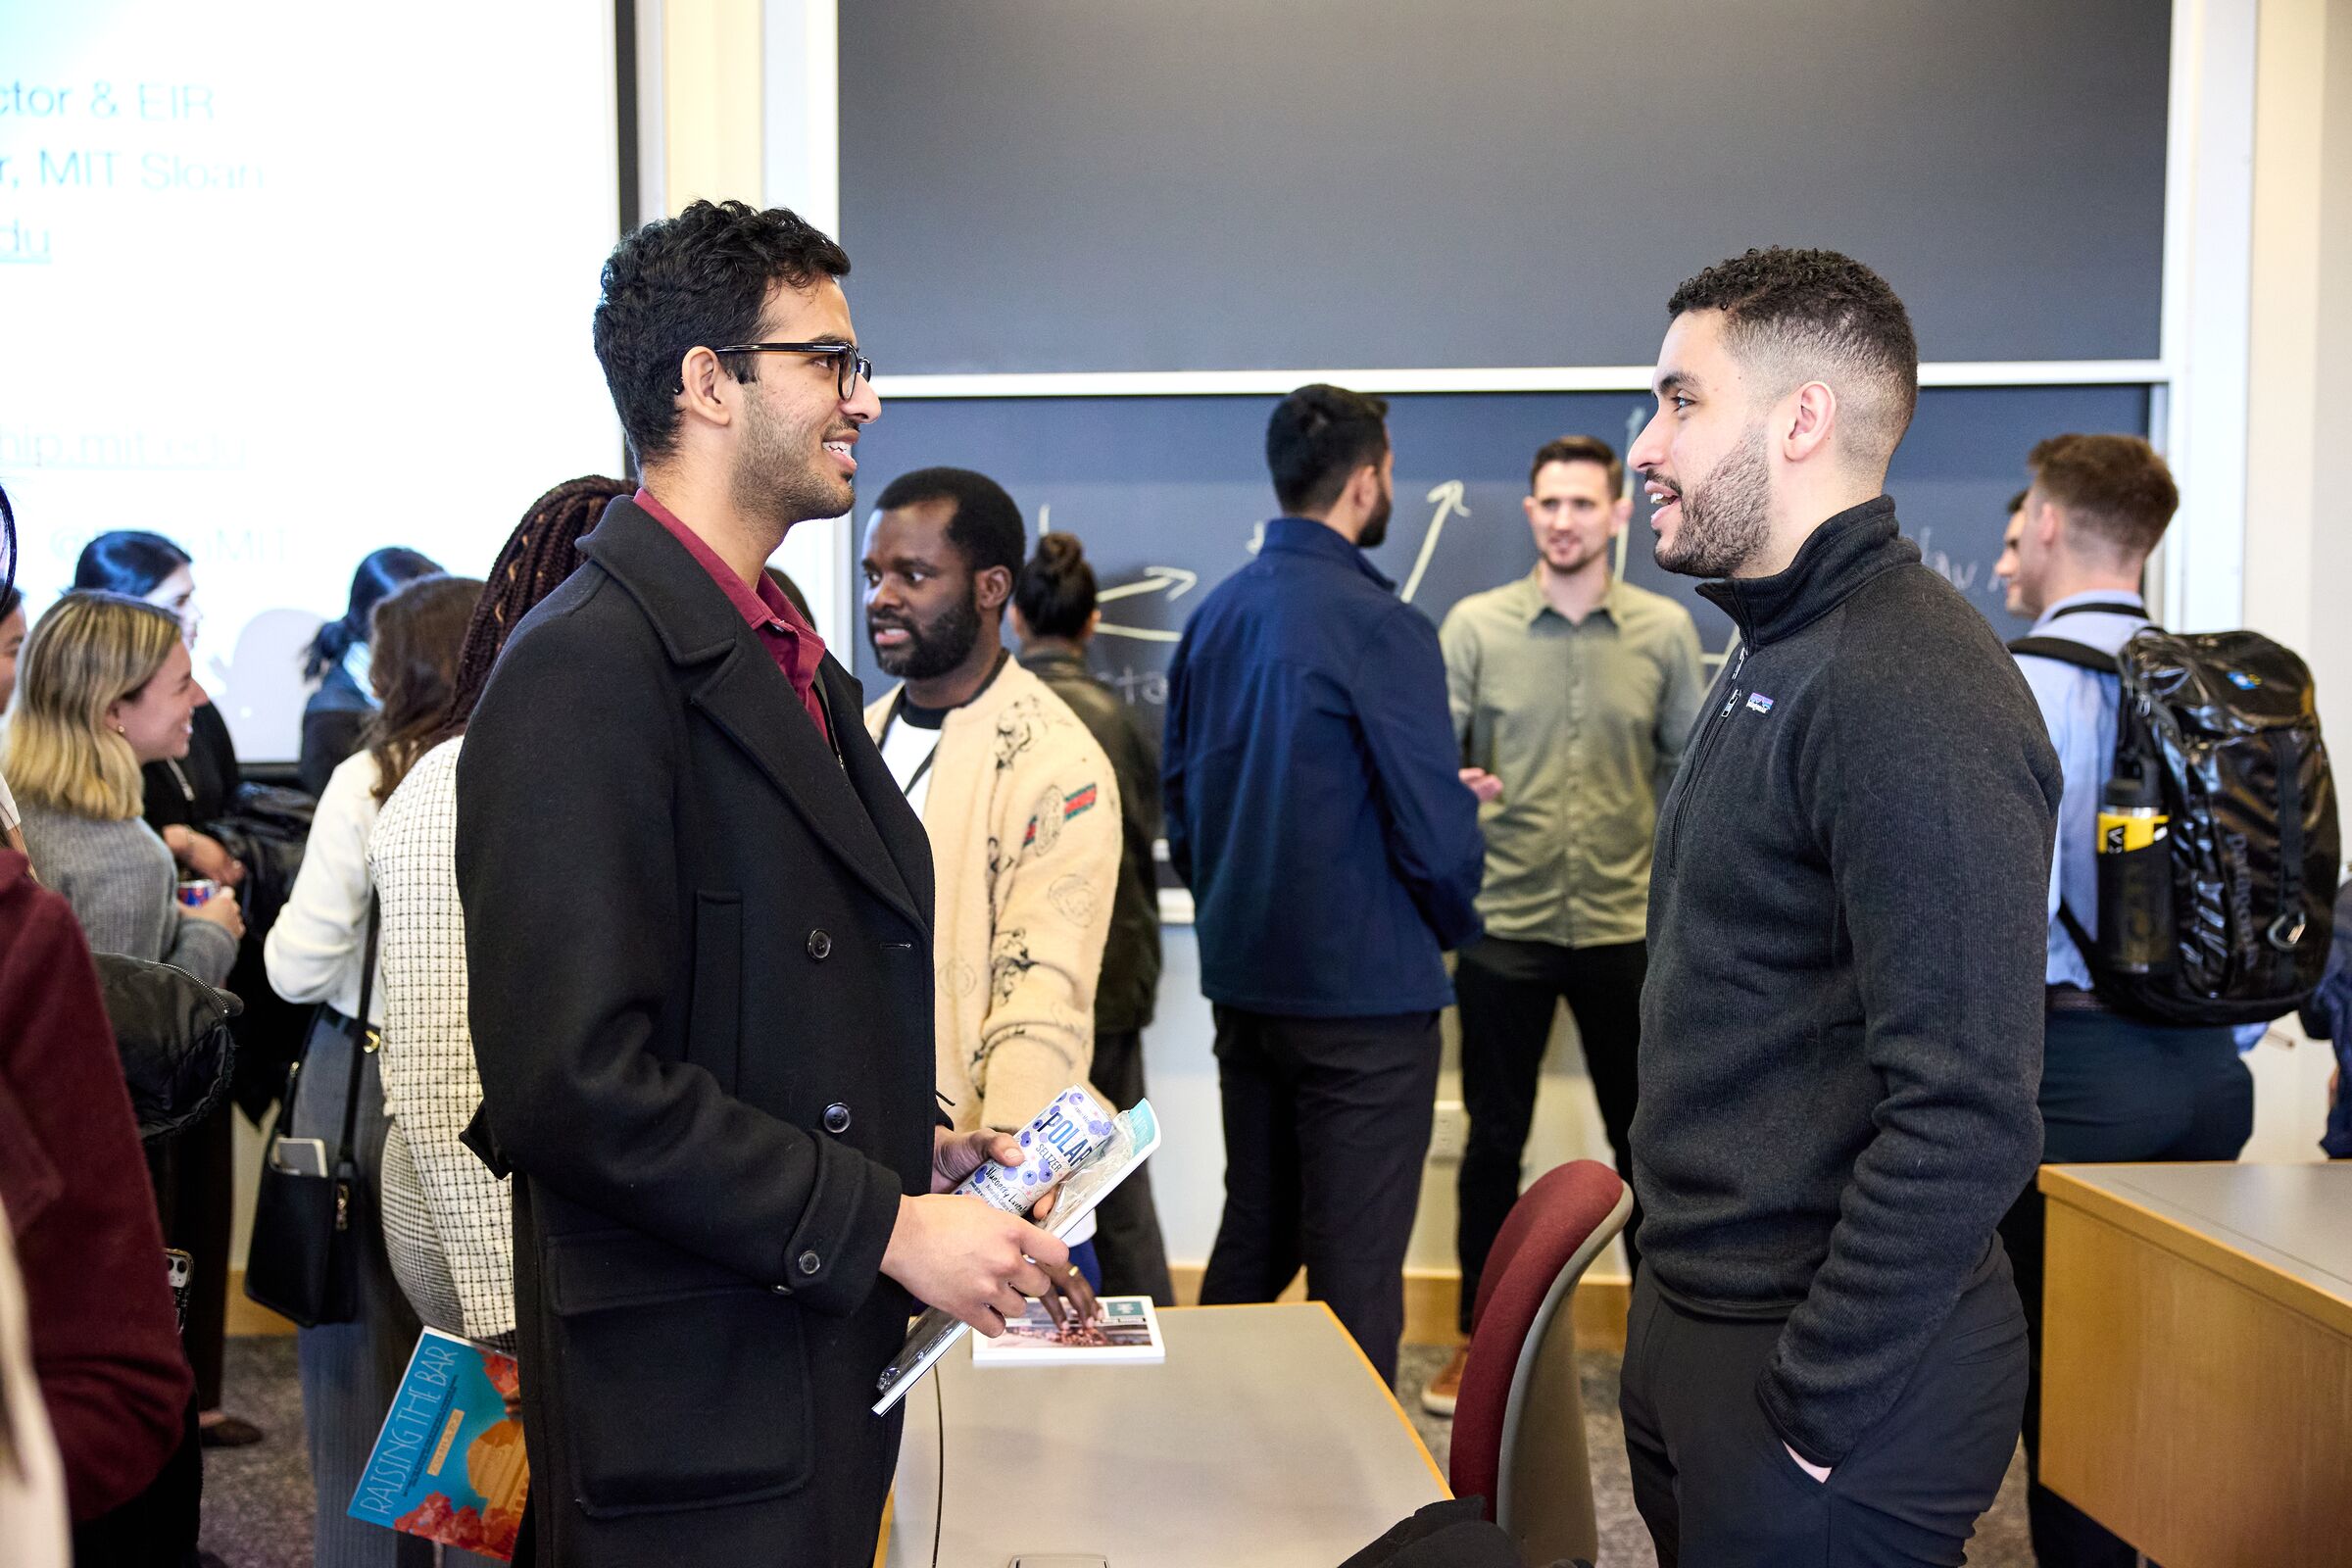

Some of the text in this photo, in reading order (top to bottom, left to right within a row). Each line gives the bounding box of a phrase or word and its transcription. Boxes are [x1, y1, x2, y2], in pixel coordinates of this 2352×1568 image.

[89, 78, 122, 119] &
[136, 79, 217, 122] EIR
[37, 146, 122, 189] MIT
[140, 147, 265, 193] Sloan
[1036, 1144, 1062, 1173] SELTZER
[1037, 1112, 1093, 1166] POLAR
[986, 1166, 1010, 1199] Blueberry
[415, 1346, 459, 1387] BAR
[396, 1386, 441, 1426] THE
[360, 1428, 423, 1515] RAISING
